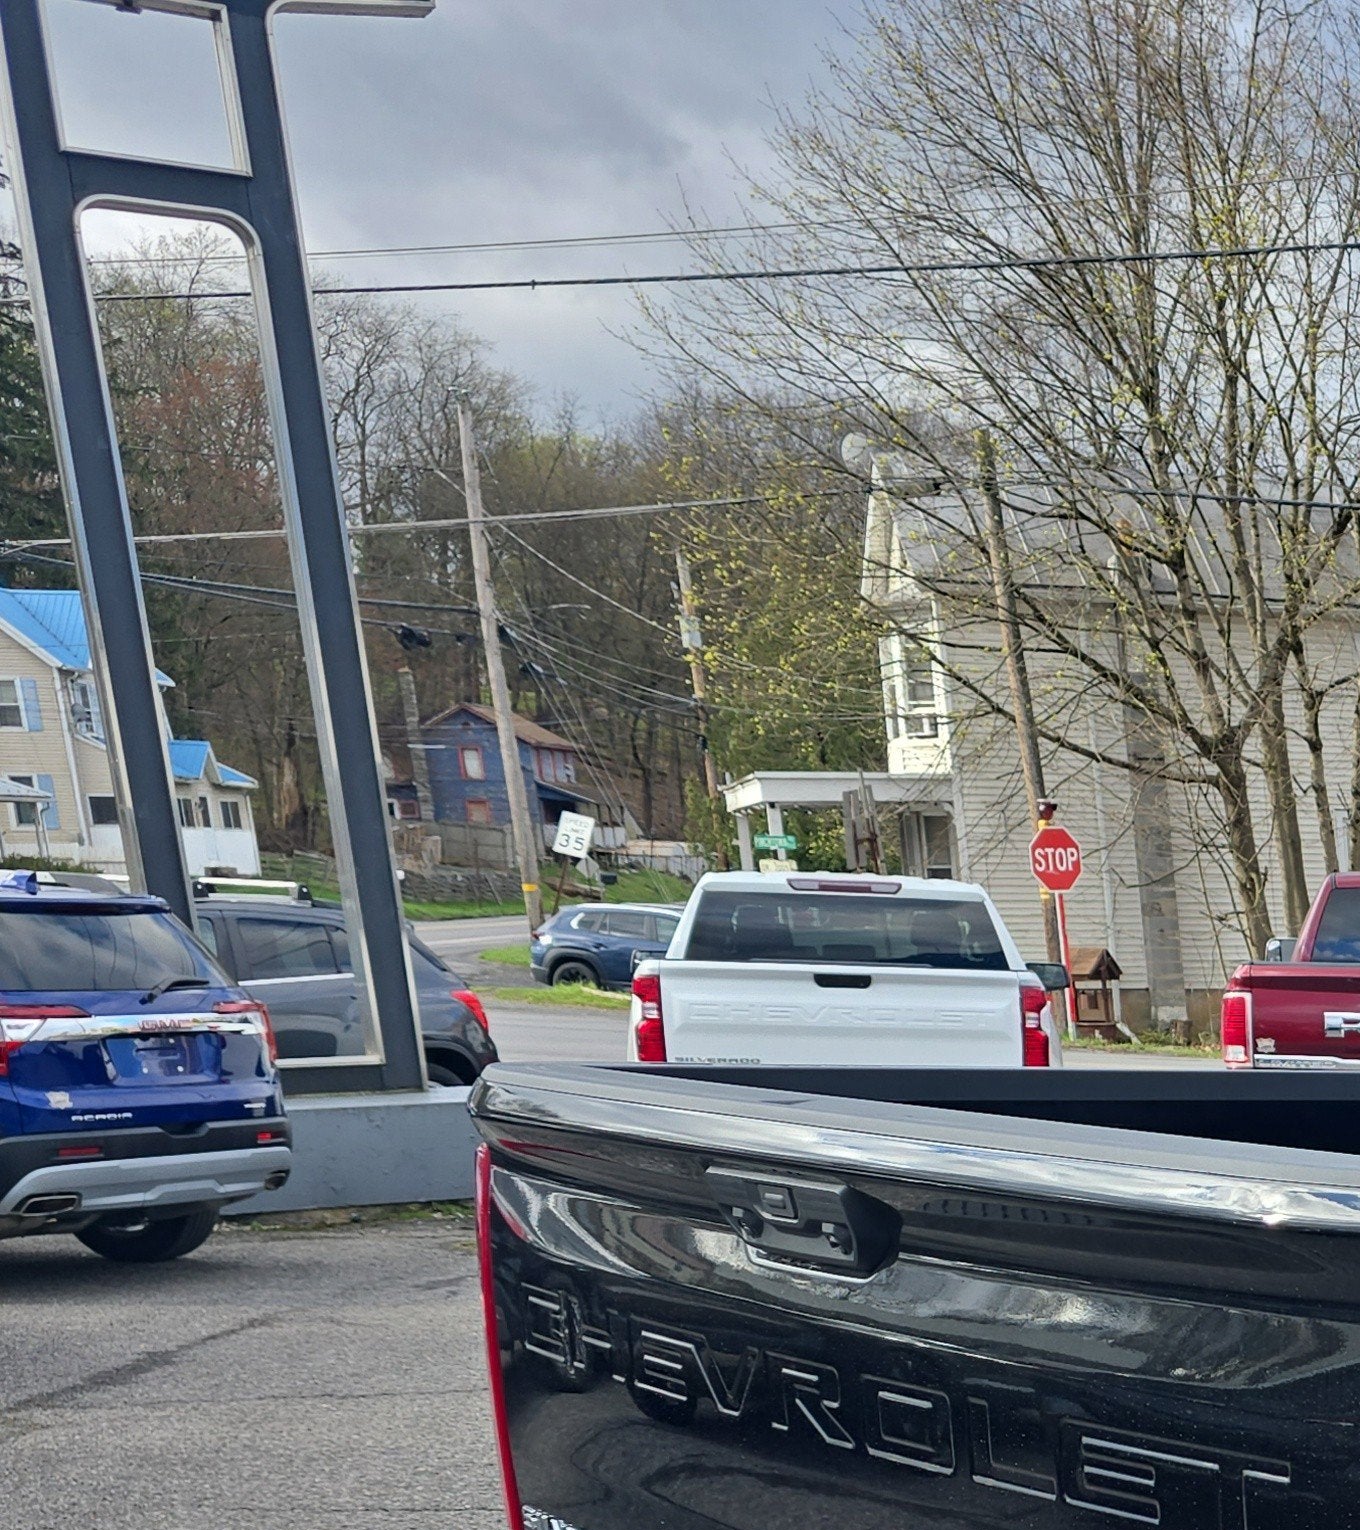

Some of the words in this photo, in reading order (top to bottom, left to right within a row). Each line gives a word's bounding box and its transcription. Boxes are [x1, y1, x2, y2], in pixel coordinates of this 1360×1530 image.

[559, 834, 585, 850] 35
[1034, 847, 1078, 872] STOP
[688, 1002, 996, 1027] CHEVROLET
[139, 1019, 192, 1031] GMC
